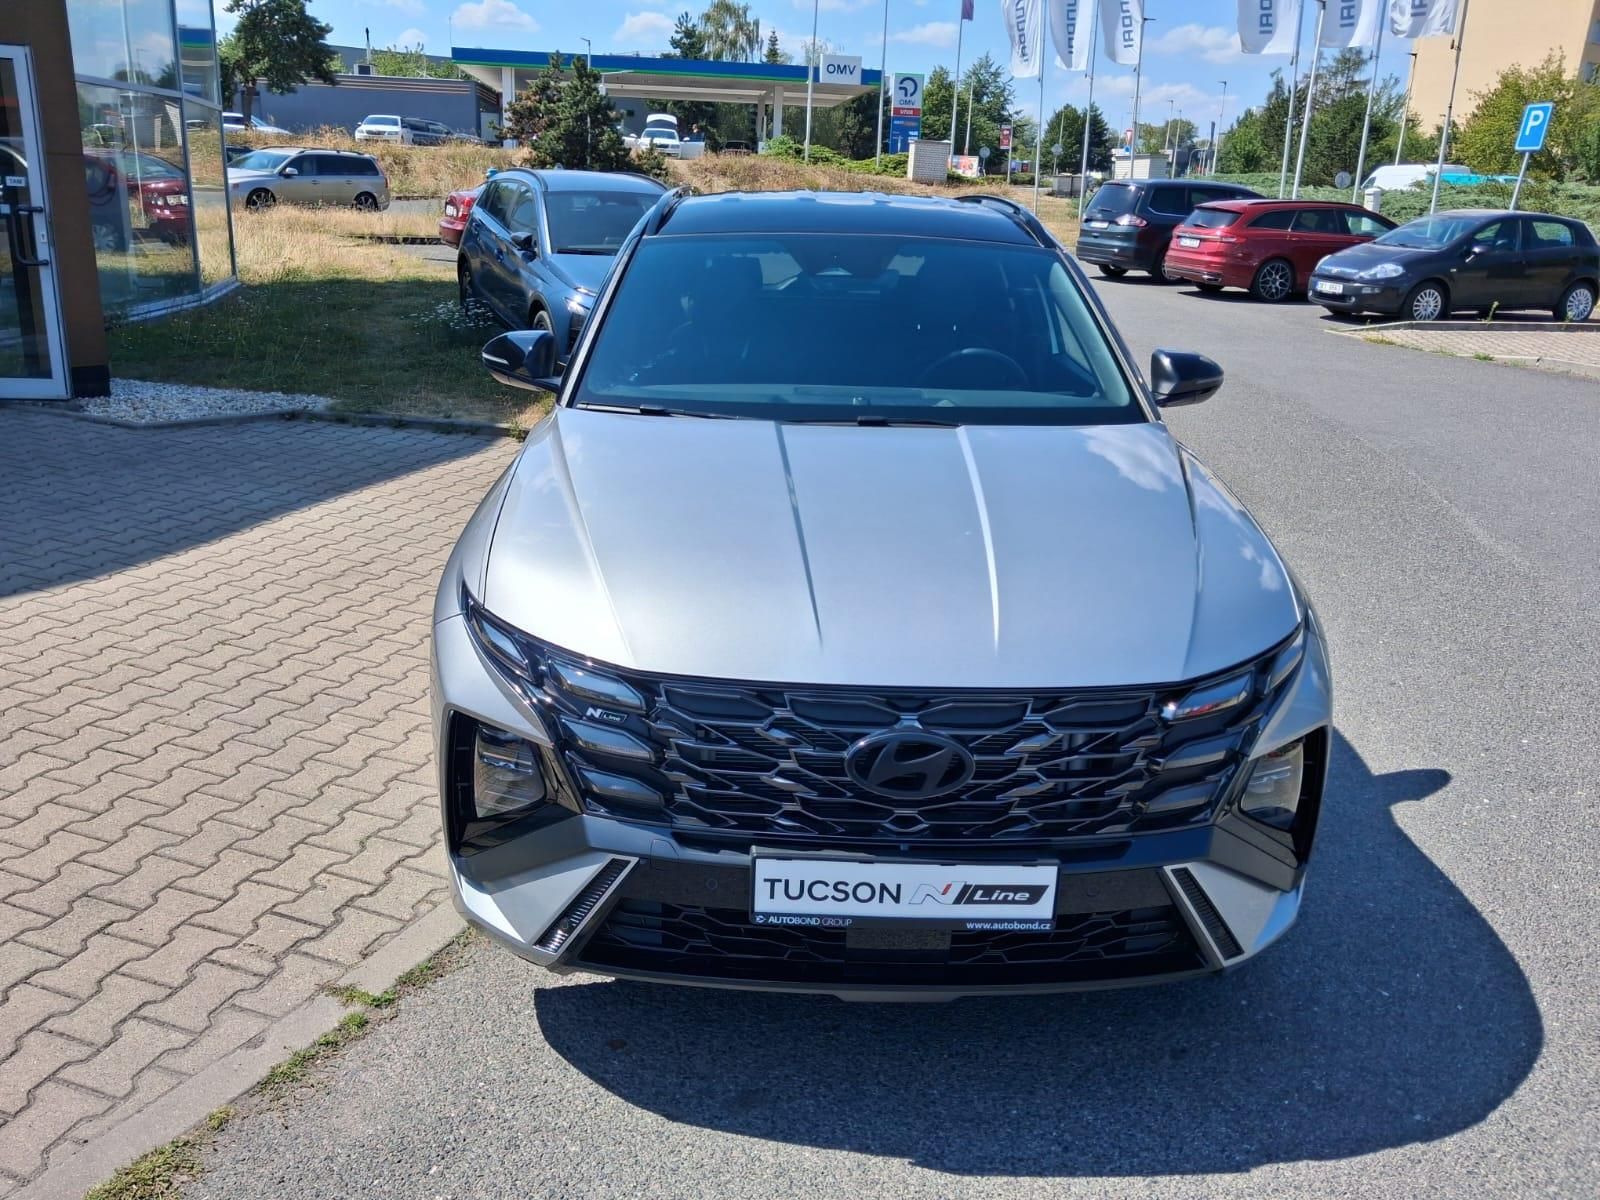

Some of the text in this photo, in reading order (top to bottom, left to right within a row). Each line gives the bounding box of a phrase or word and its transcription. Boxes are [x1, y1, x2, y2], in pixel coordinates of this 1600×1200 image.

[826, 63, 857, 75] OMV
[1525, 110, 1545, 136] P
[763, 878, 902, 904] TUCSON
[973, 889, 1030, 901] Line
[768, 915, 853, 927] AUTOBOND GROUP
[966, 921, 1051, 931] www.autobond.cz
